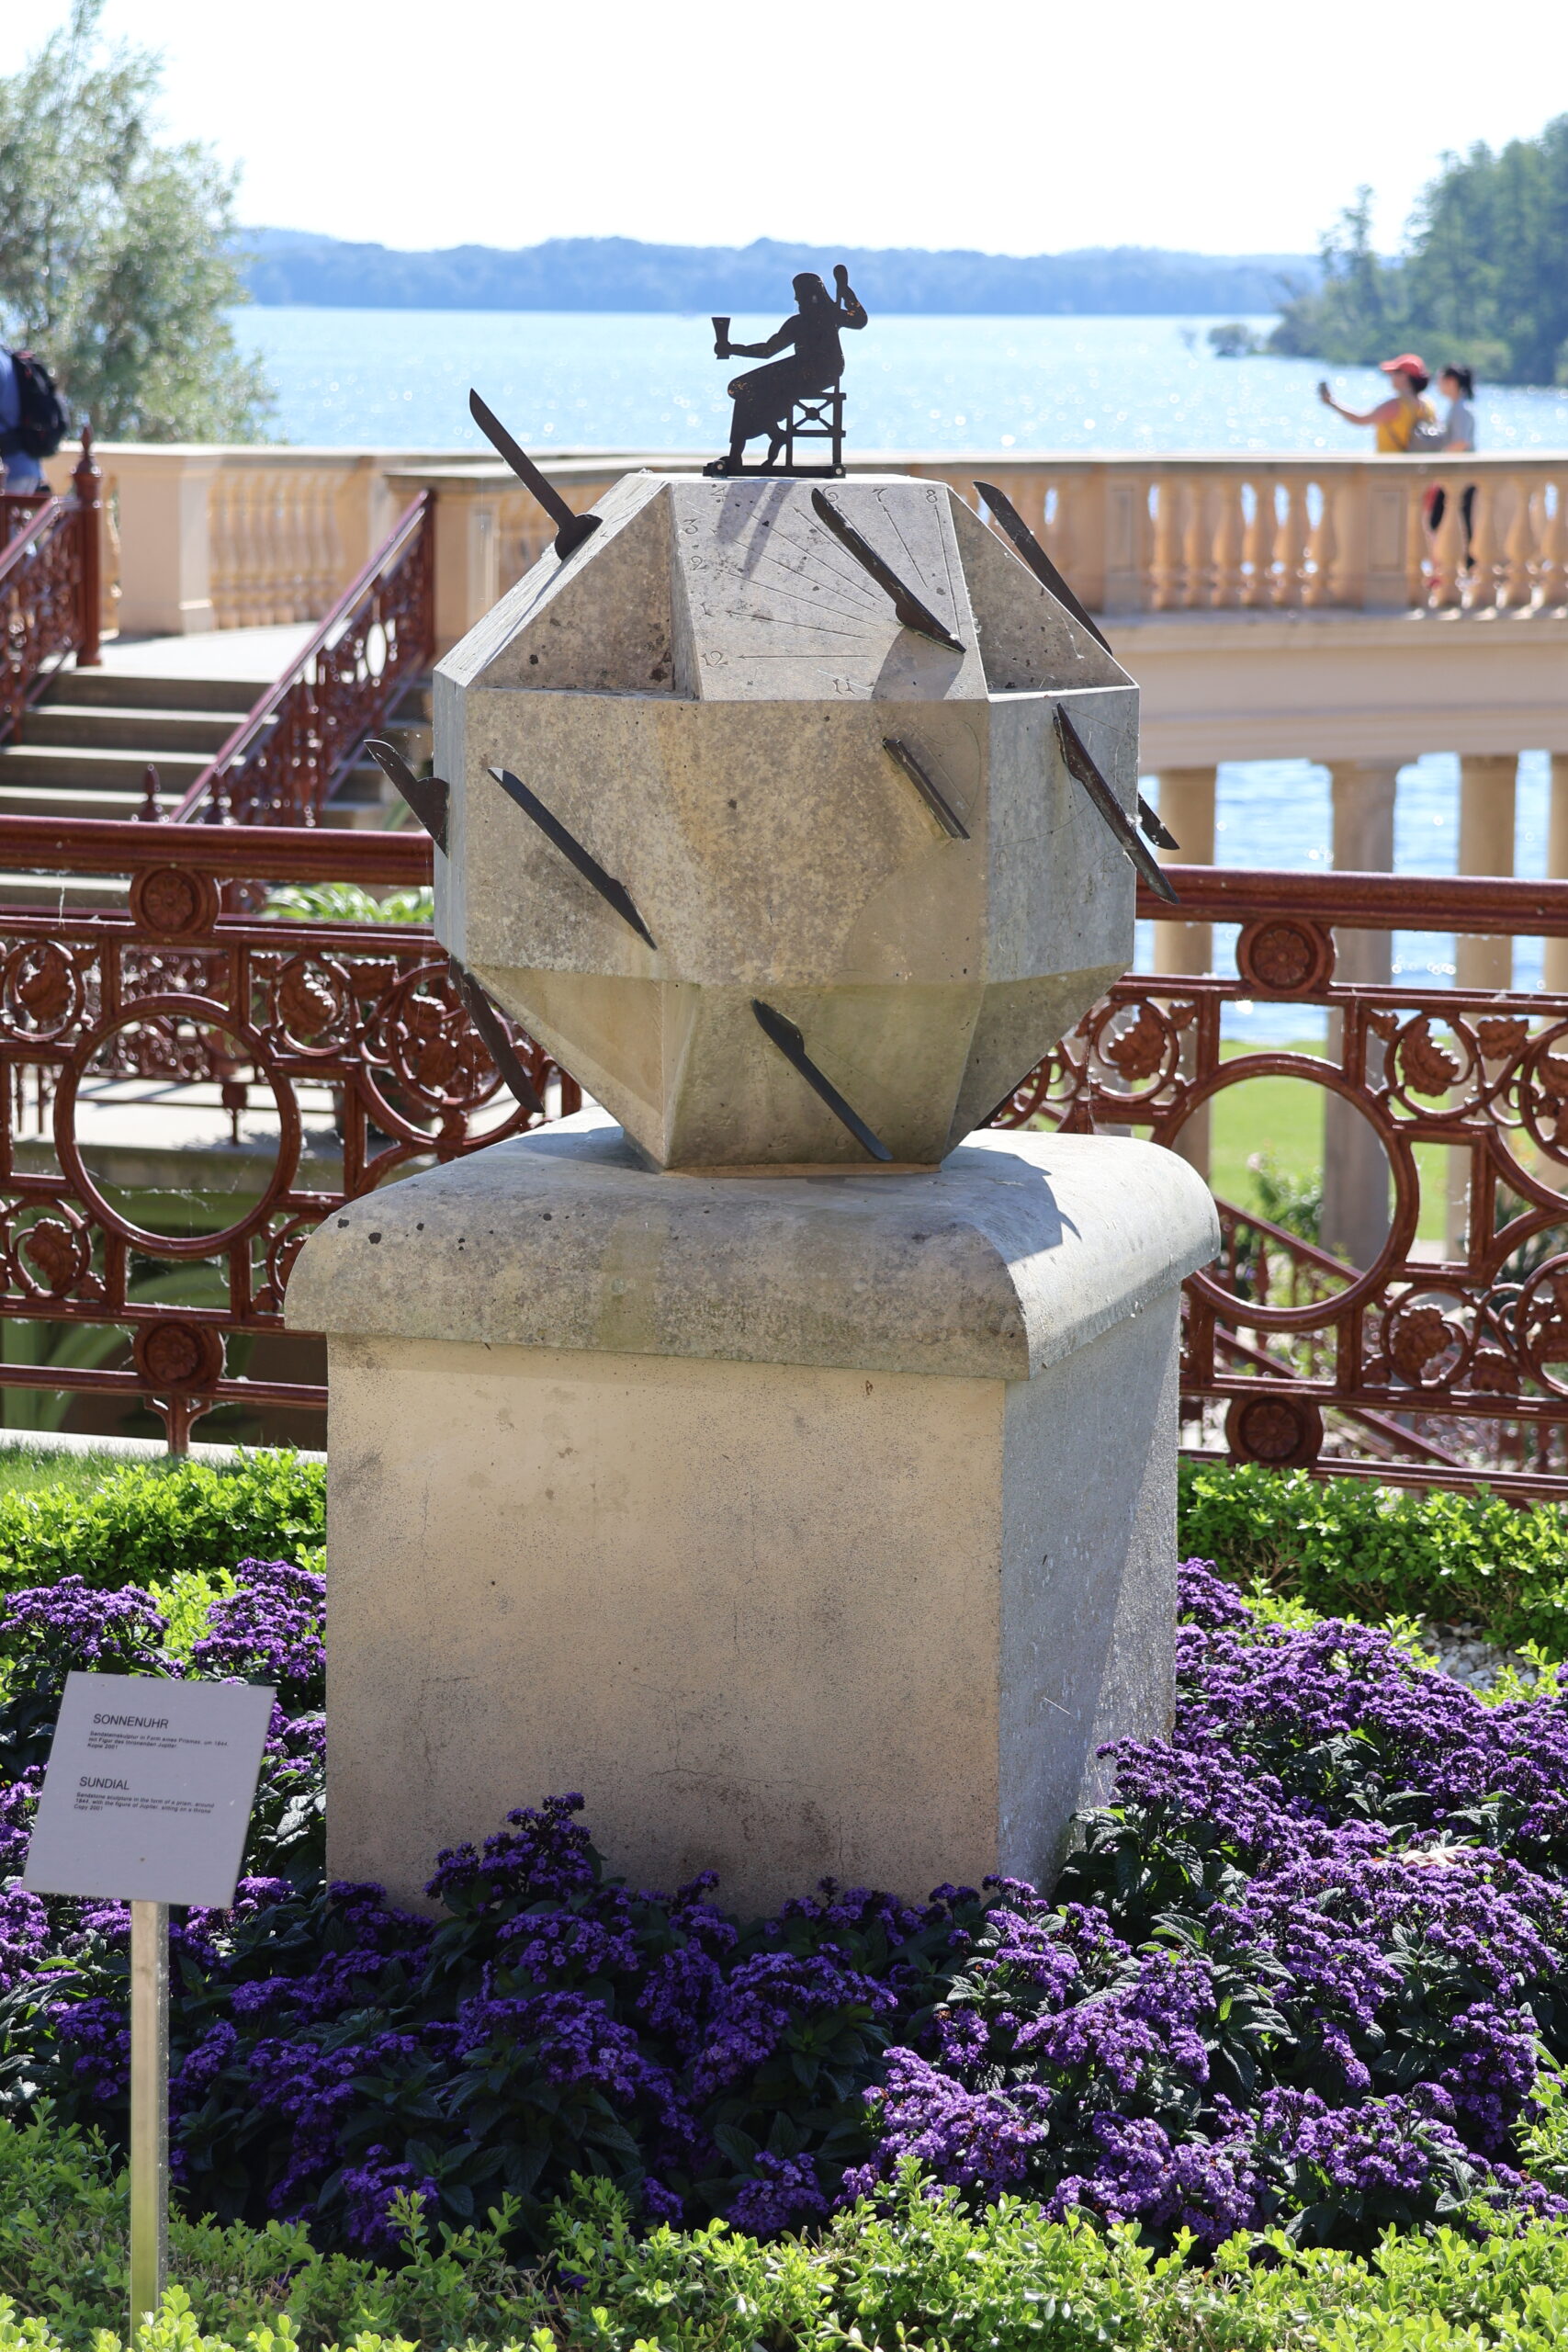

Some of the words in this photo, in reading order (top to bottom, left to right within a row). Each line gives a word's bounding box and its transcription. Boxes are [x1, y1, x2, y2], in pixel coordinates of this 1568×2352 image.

[709, 486, 728, 503] 4
[822, 484, 840, 503] 6
[872, 487, 888, 503] 7
[926, 489, 938, 503] 8
[682, 517, 699, 535] 3
[690, 556, 708, 571] 2
[700, 650, 729, 669] 12
[831, 678, 858, 696] 11
[93, 1713, 169, 1730] SONNENUHR
[79, 1776, 130, 1791] SUNDIAL
